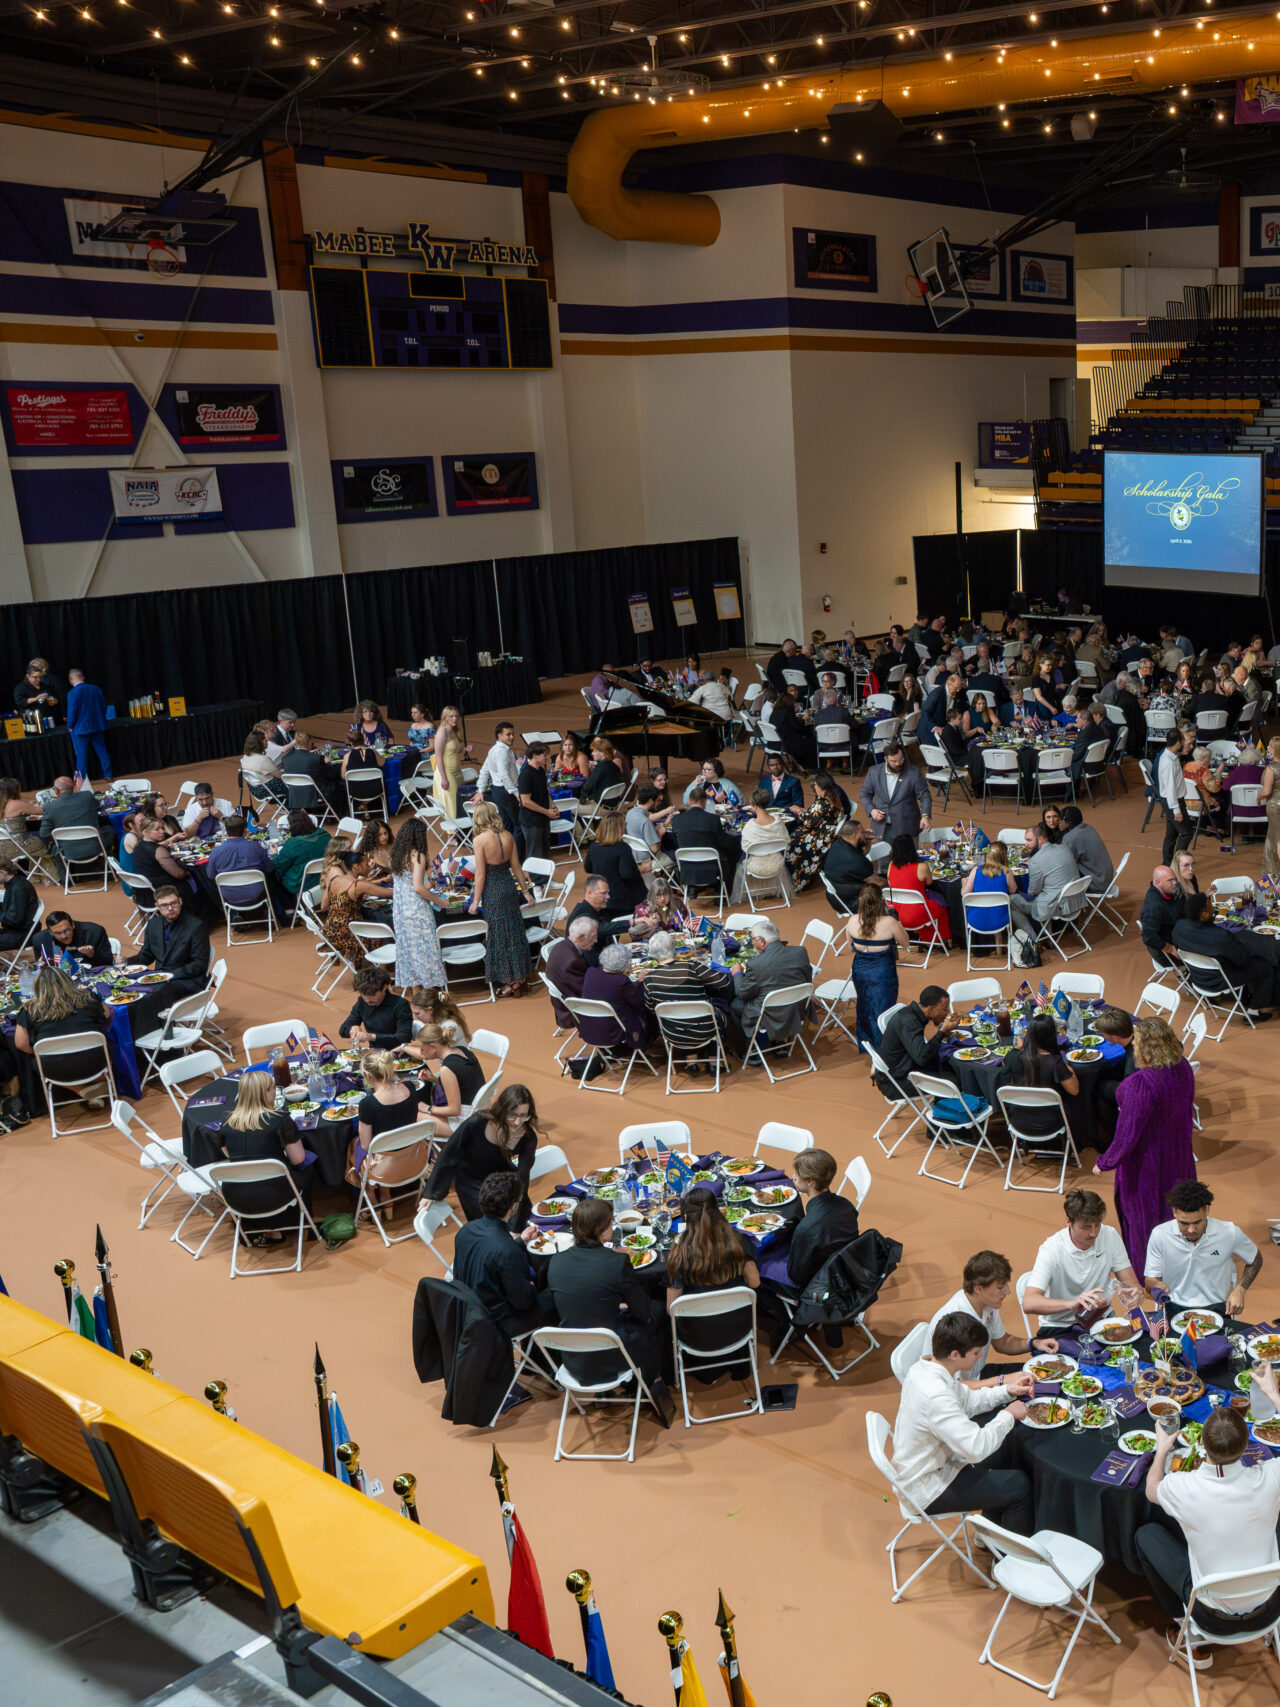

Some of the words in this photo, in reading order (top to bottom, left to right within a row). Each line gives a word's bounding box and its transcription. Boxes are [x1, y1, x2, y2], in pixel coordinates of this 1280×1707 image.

[314, 229, 396, 257] MABEE
[468, 242, 539, 267] ARENA
[430, 305, 450, 313] PERIOD
[197, 404, 258, 424] Freddy's
[126, 481, 158, 492] NAIA
[1124, 472, 1203, 503] Scholarship
[1196, 478, 1241, 508] Gala
[181, 491, 203, 499] KCAC
